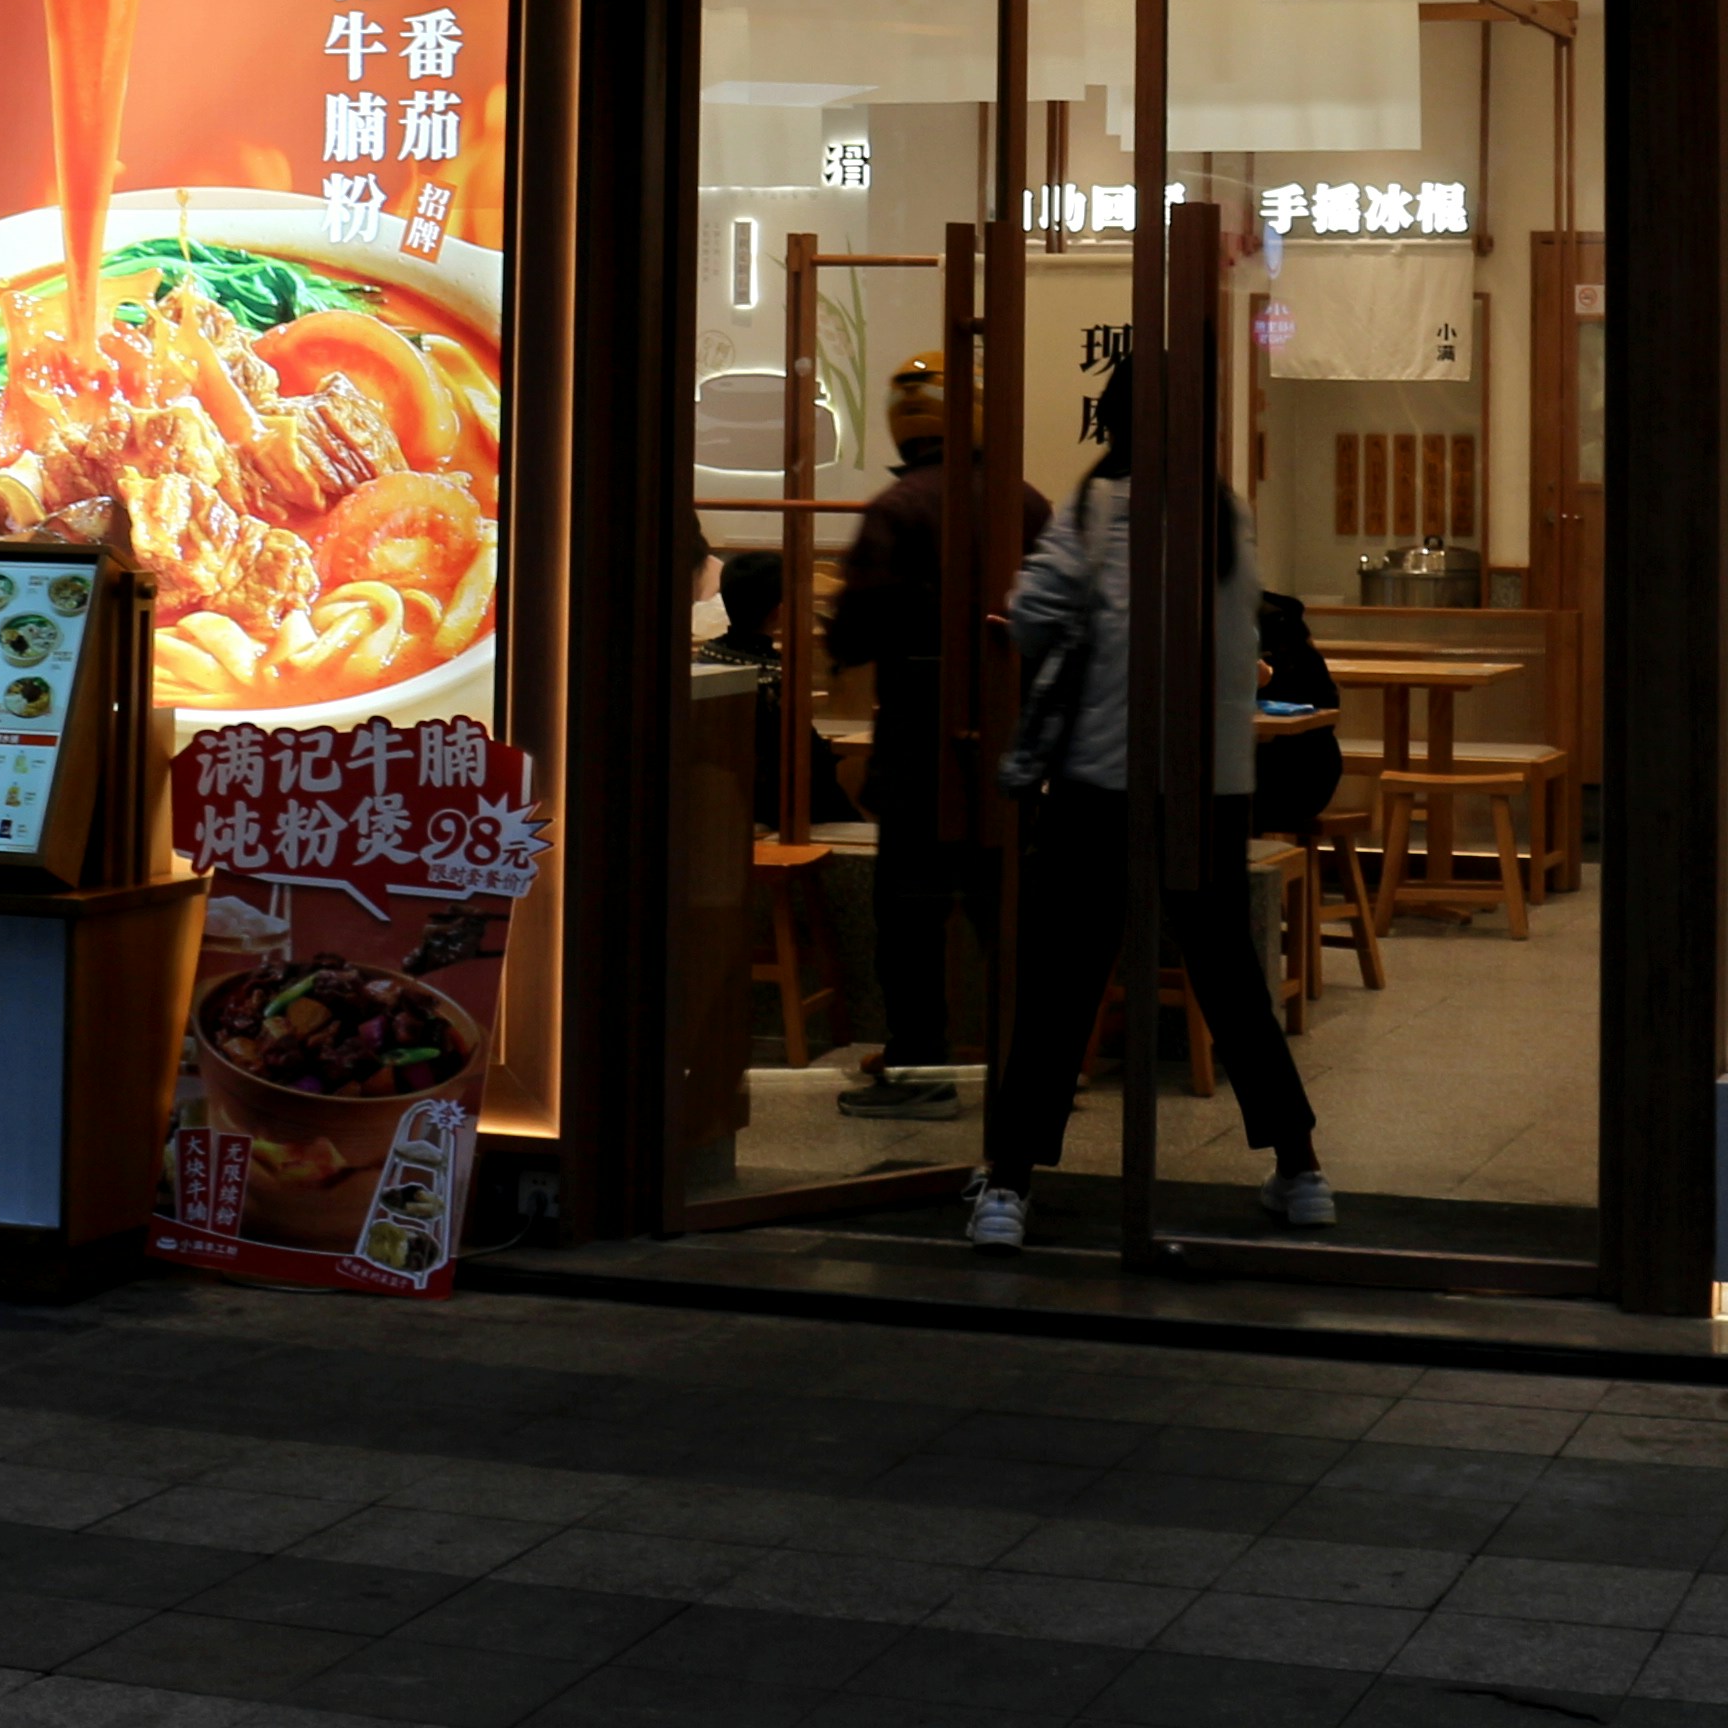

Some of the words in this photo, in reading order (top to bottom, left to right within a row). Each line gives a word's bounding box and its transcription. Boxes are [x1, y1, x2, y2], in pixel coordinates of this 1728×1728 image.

[406, 182, 451, 253] 招牌
[1259, 181, 1470, 235] 手摇冰棍
[1436, 323, 1458, 362] 小满
[194, 719, 487, 799] 满记牛腩
[193, 793, 421, 870] 炖粉煲
